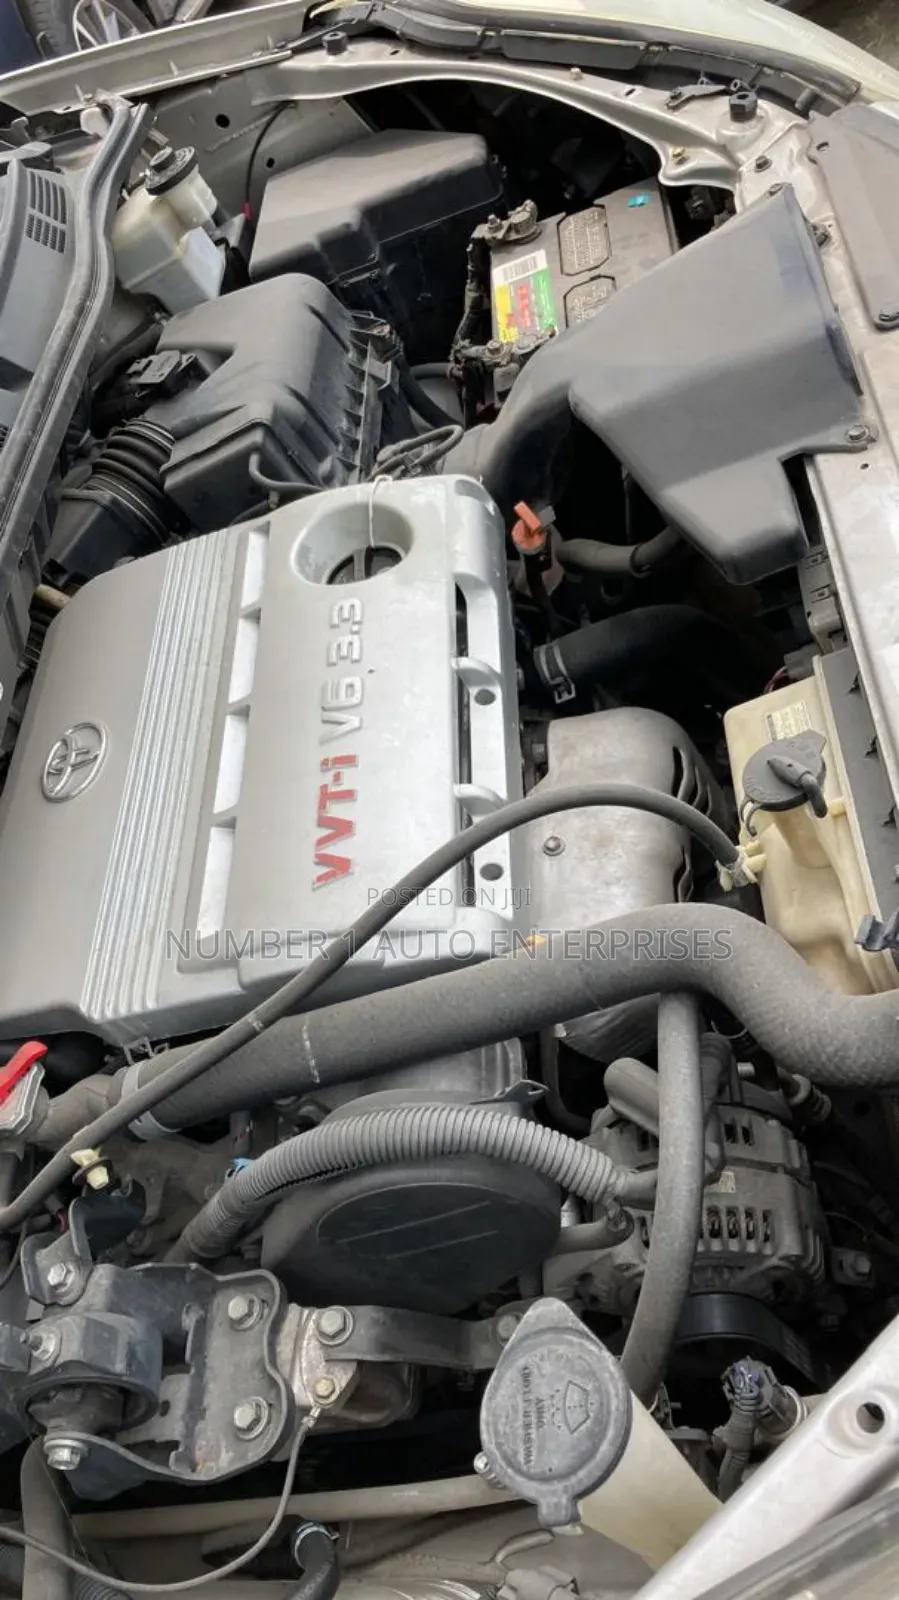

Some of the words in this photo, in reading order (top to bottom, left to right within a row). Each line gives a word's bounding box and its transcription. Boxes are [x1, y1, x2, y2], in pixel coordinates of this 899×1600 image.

[325, 598, 363, 667] 3.3
[318, 677, 363, 746] V6
[310, 754, 358, 891] VVT-i
[522, 1410, 534, 1468] WASHER
[534, 1396, 546, 1430] ONLY
